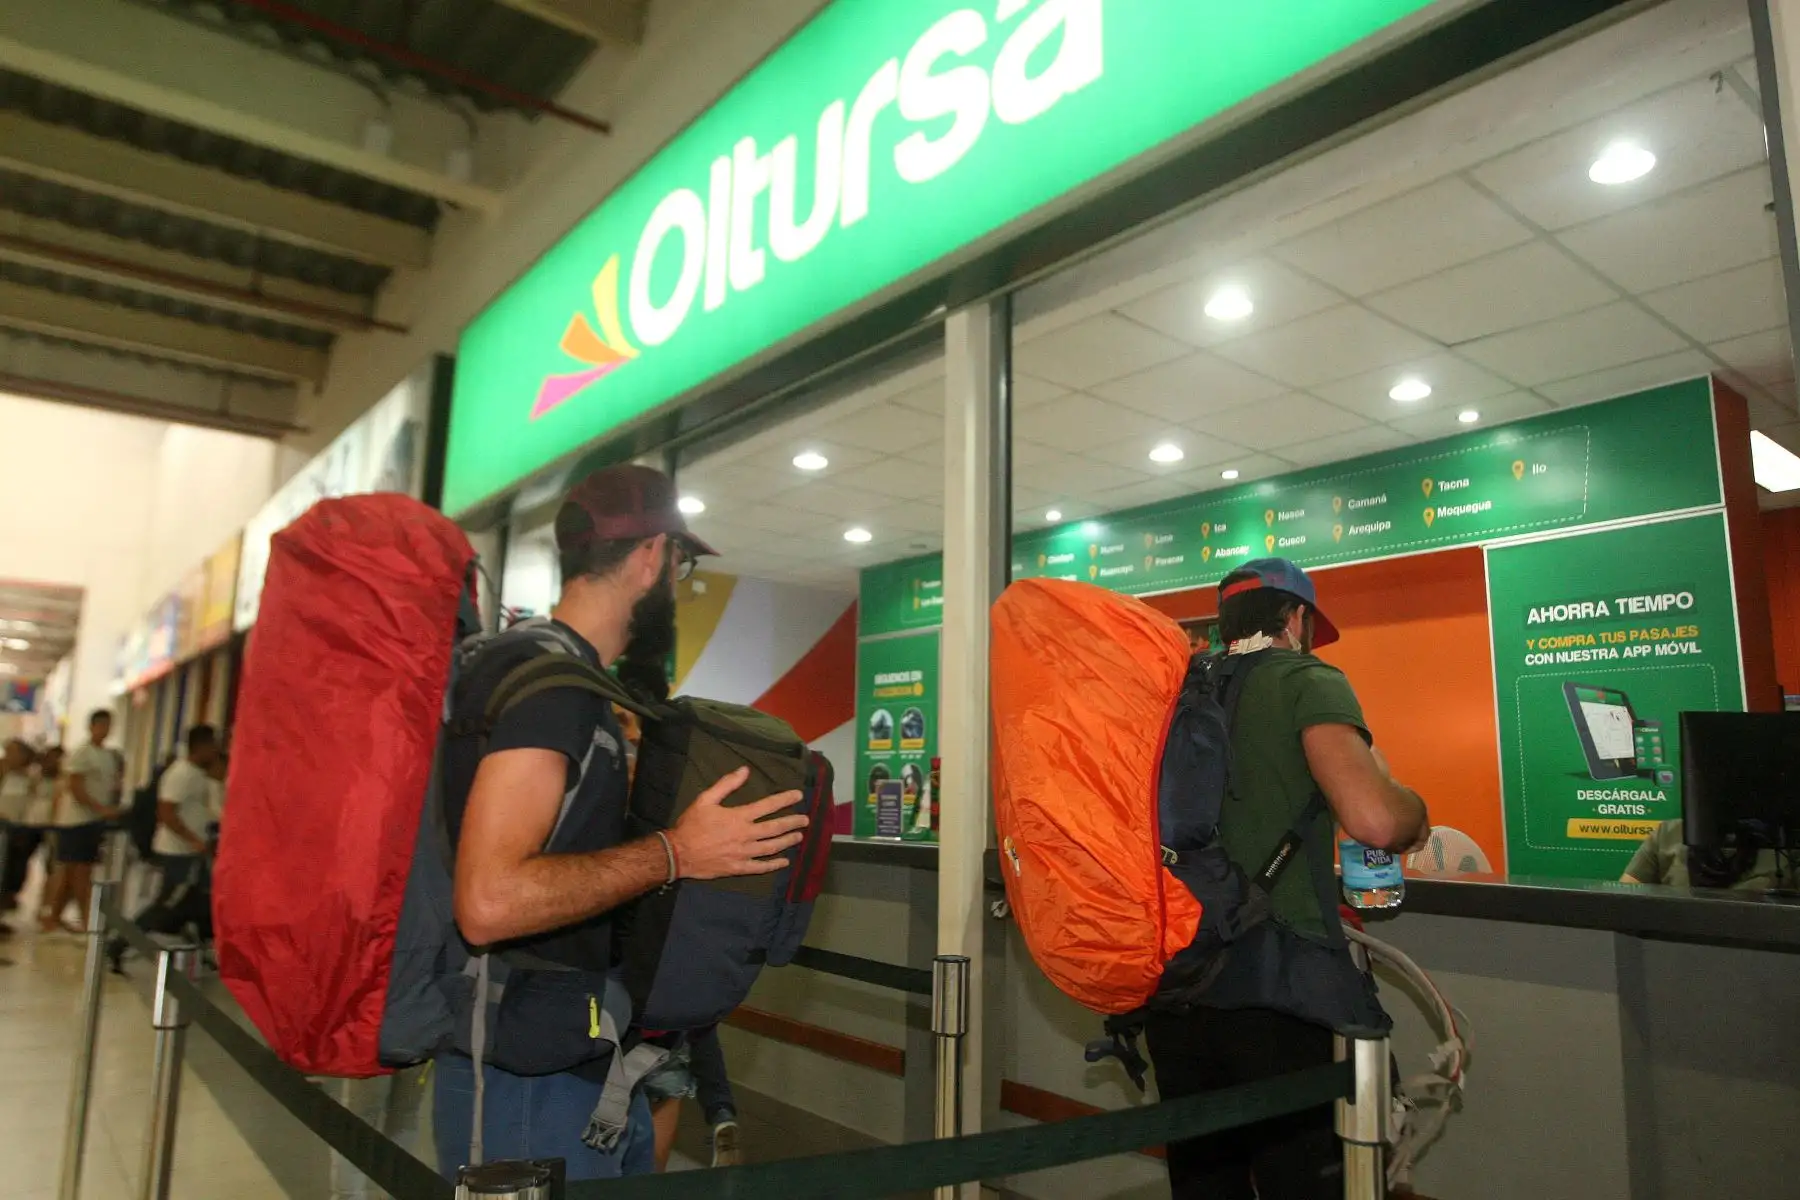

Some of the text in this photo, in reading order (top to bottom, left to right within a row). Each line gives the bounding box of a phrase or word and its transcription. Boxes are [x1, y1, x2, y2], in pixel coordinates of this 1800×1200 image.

[628, 0, 1104, 348] Oltursa
[1532, 463, 1547, 475] Ilo
[1438, 478, 1470, 492] Tacna
[1348, 493, 1387, 510] Camaná
[1437, 500, 1492, 518] Moquegua
[1214, 523, 1227, 533] Ica
[1348, 520, 1391, 536] Arequipa
[1215, 544, 1250, 559] Abancay
[1527, 592, 1694, 625] AHORRA TIEMPO
[1526, 625, 1699, 650] Y COMPRA TUS PASAJES
[1525, 641, 1702, 666] CON NUESTRA APP MÓVIL
[1577, 788, 1667, 801] DESCÁRGALA
[1598, 804, 1645, 815] GRATIS
